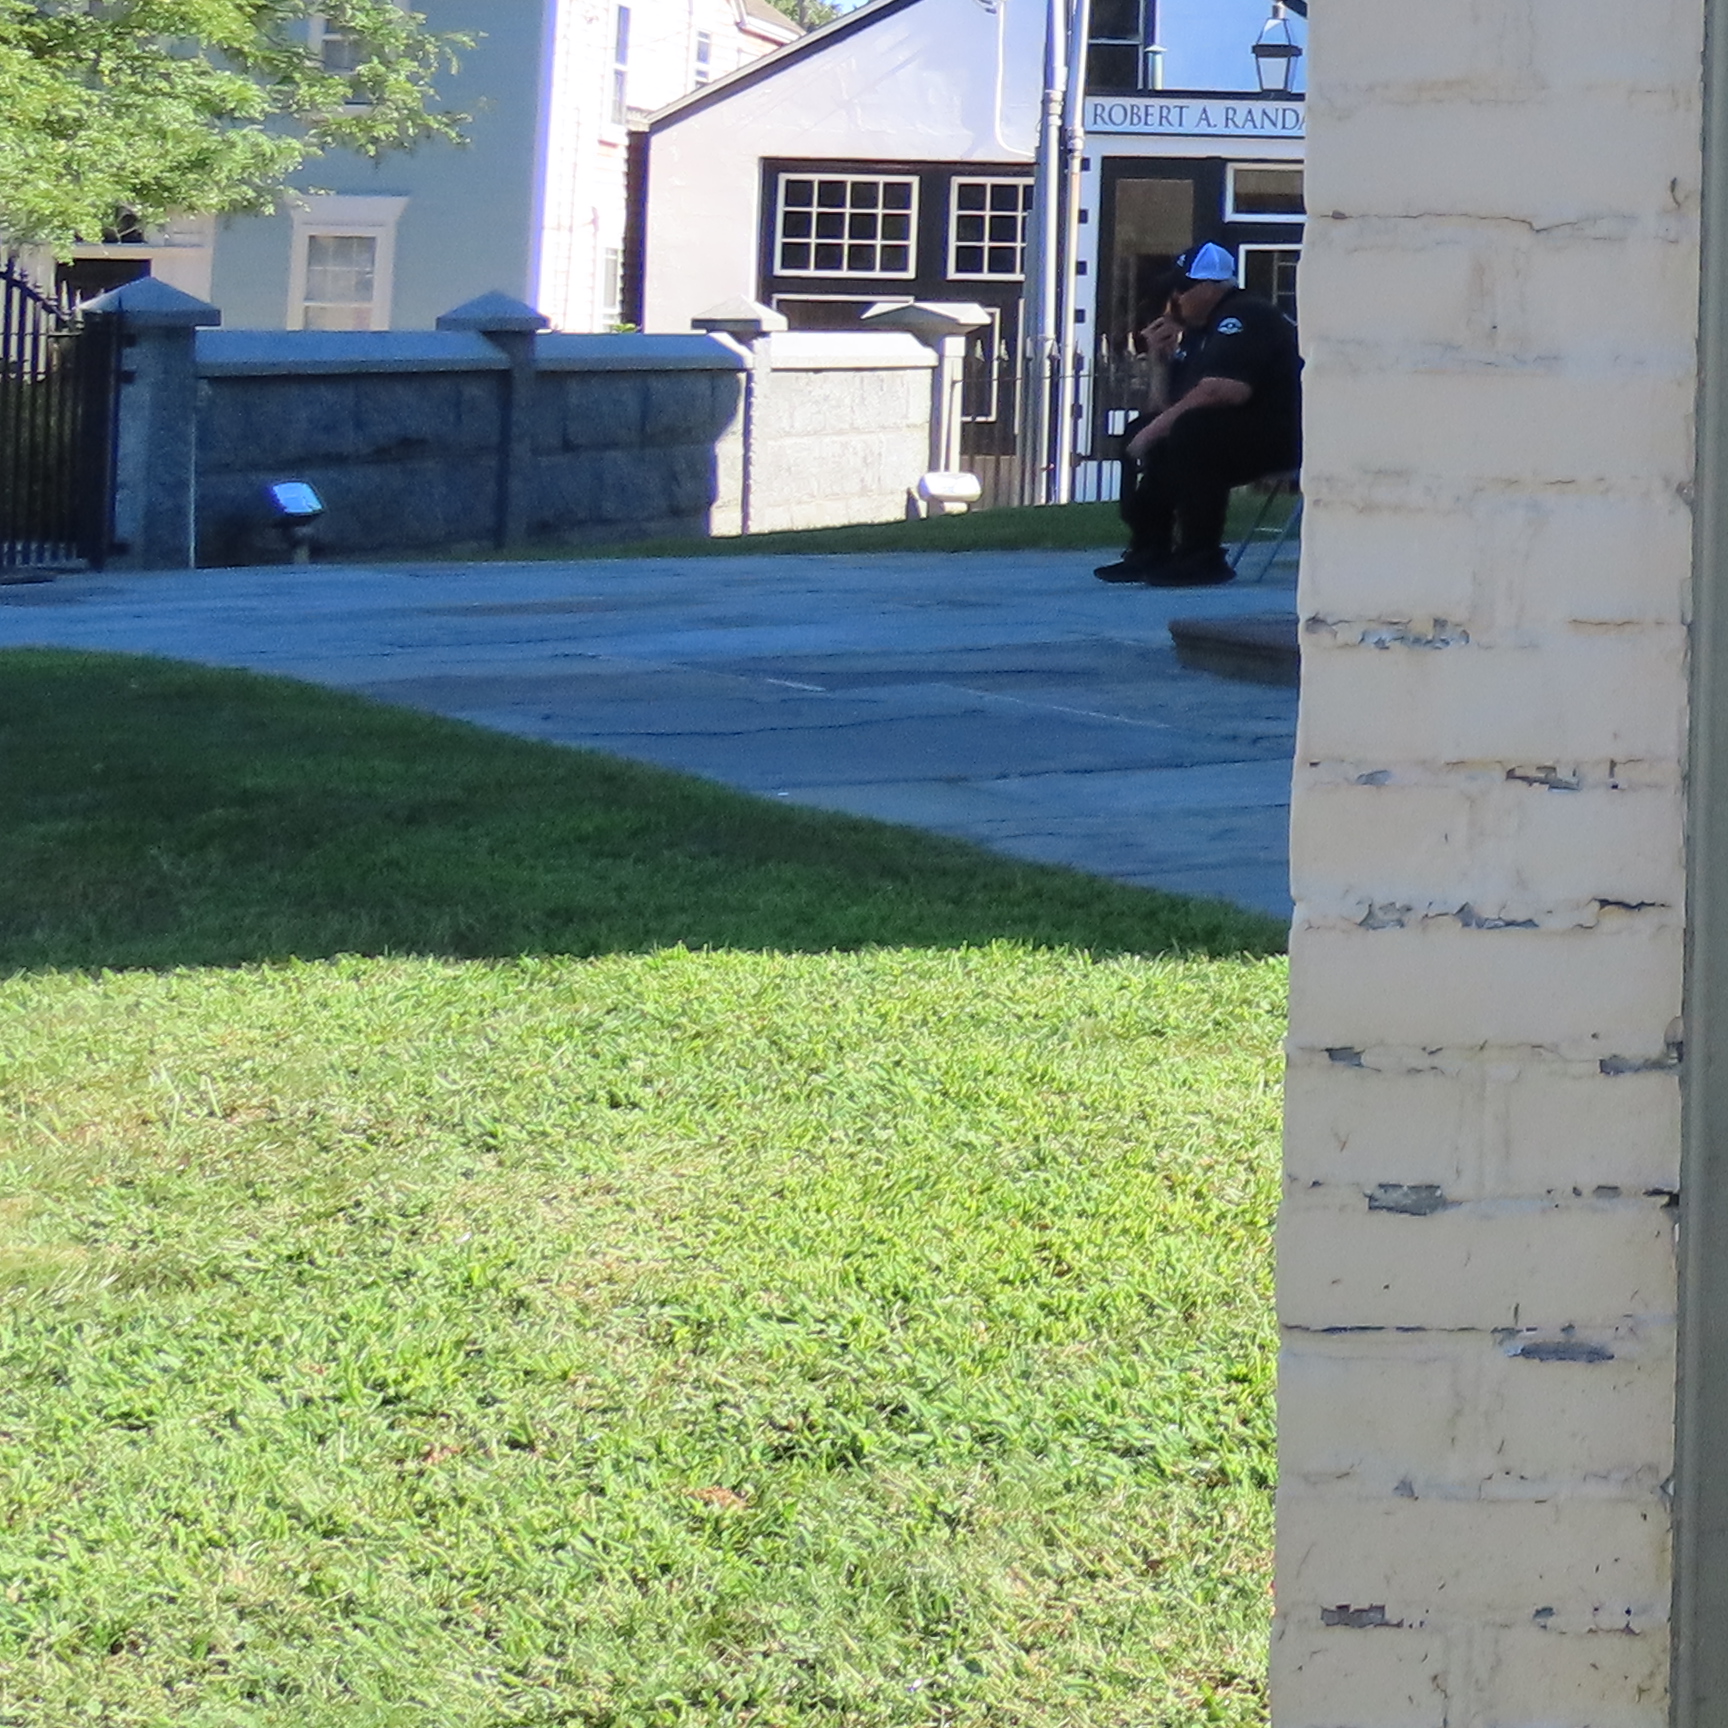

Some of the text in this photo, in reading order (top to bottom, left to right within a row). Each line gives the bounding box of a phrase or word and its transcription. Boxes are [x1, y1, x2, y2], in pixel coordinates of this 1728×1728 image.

[1093, 103, 1305, 130] ROBERT A. RAND
